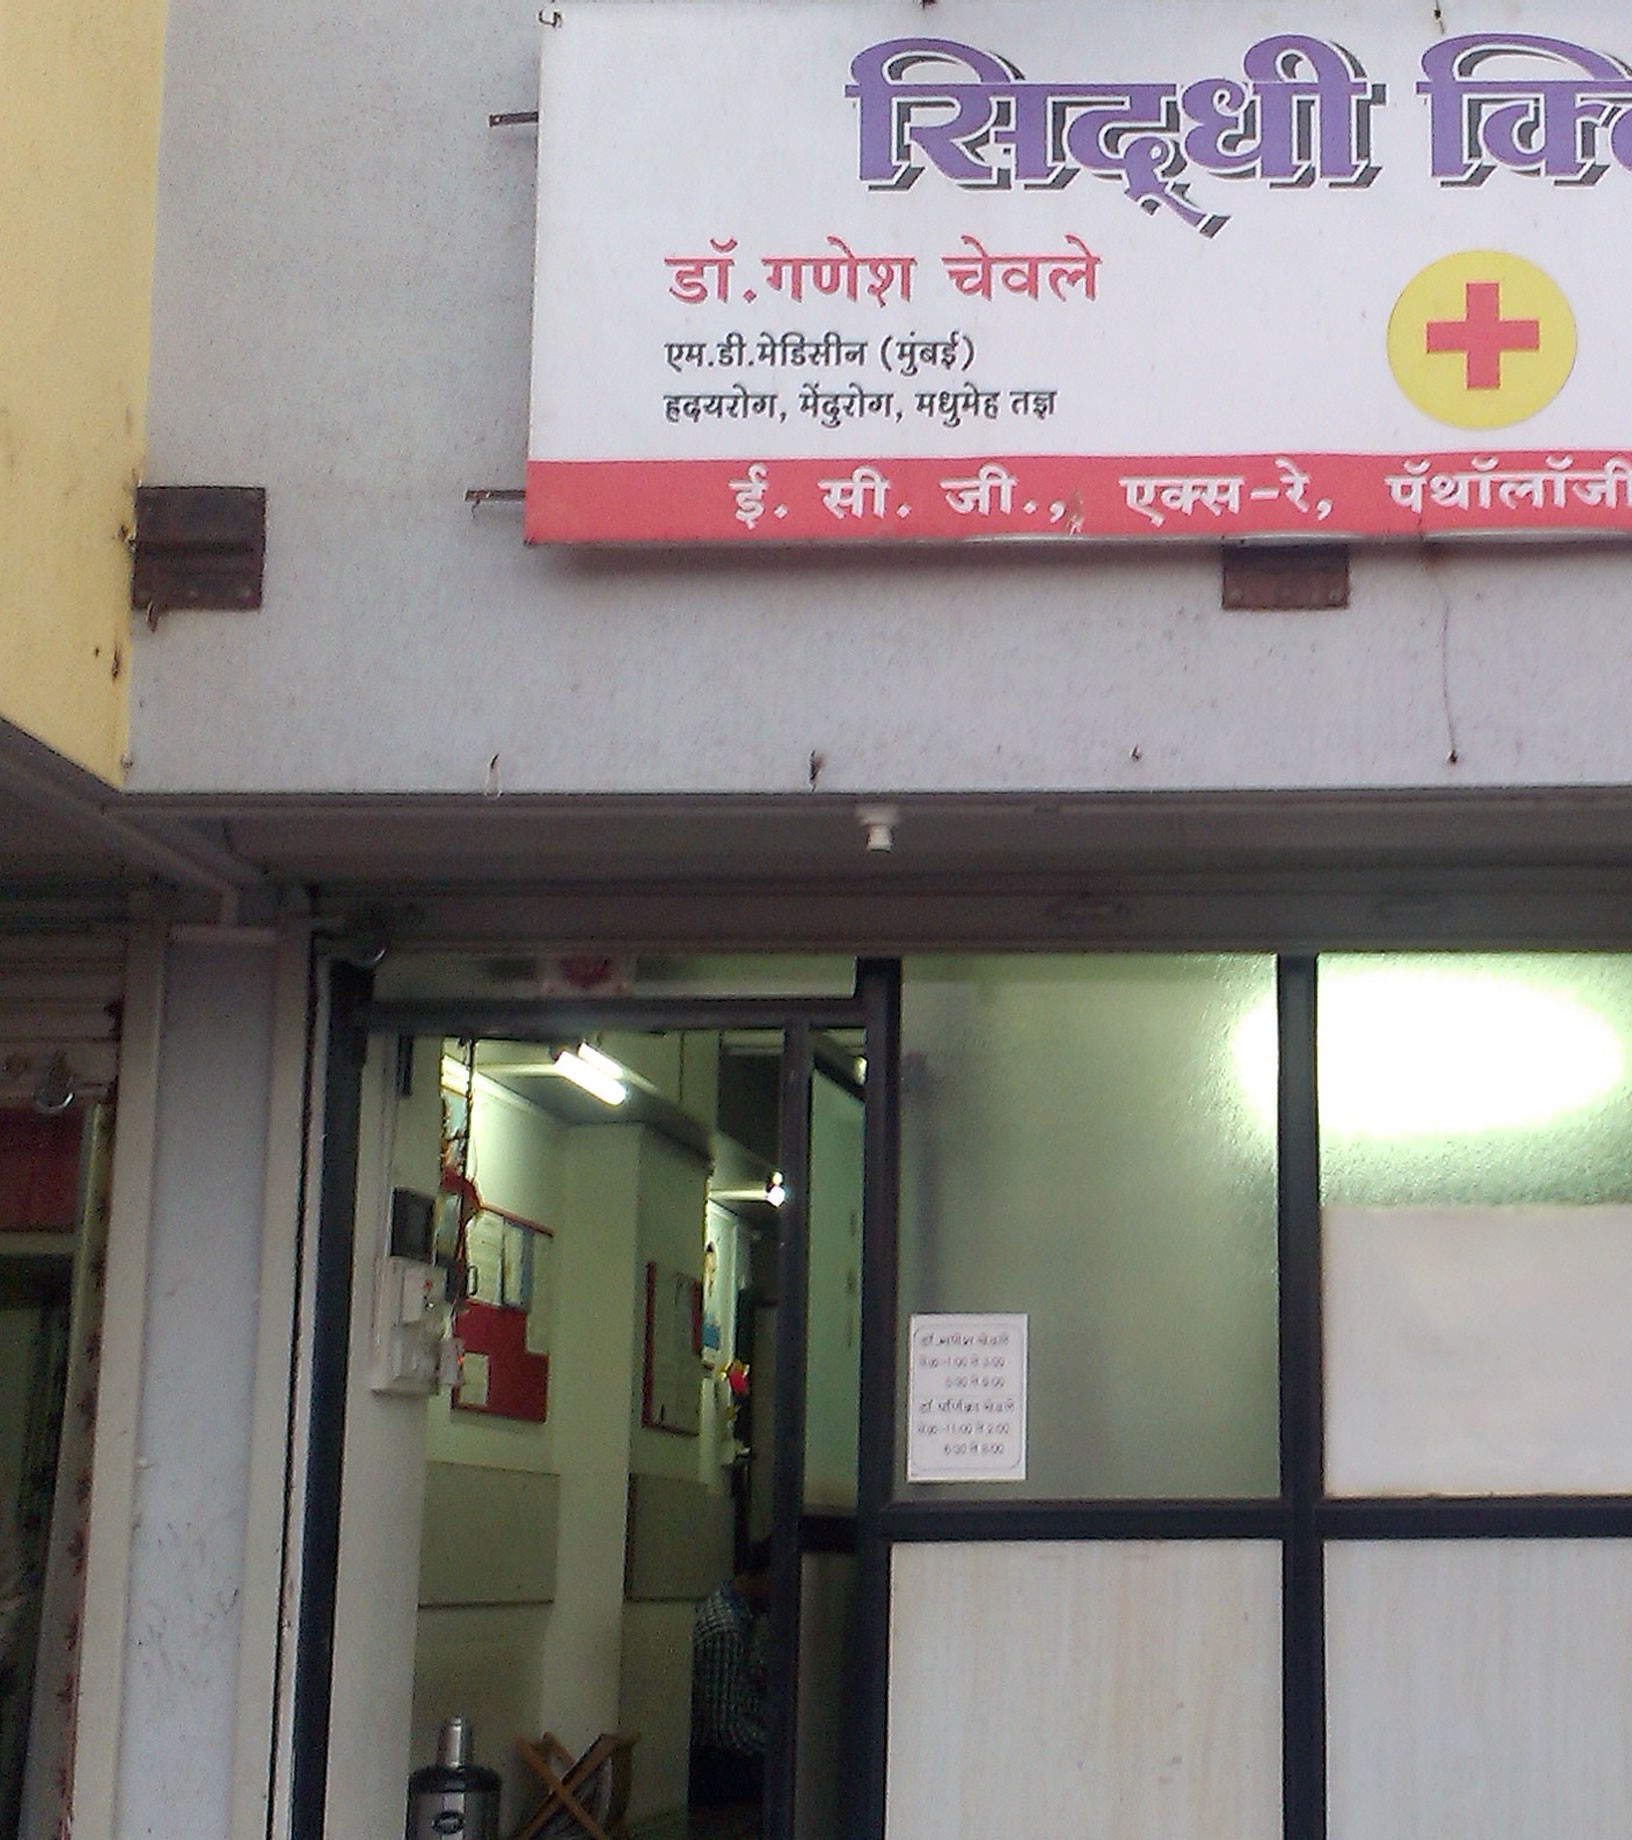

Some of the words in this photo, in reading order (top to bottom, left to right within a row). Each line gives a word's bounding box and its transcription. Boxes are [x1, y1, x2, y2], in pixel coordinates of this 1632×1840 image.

[664, 235, 917, 308] डॉ.गणेश
[941, 234, 1103, 303] चेवले
[664, 331, 868, 372] एम.डी.मेडिसीन
[880, 331, 975, 377] (मुंबई)
[915, 382, 1000, 426] मधुमेह
[1010, 389, 1058, 420] तज्ञ
[730, 464, 788, 527] ई.
[818, 465, 909, 519] सी.
